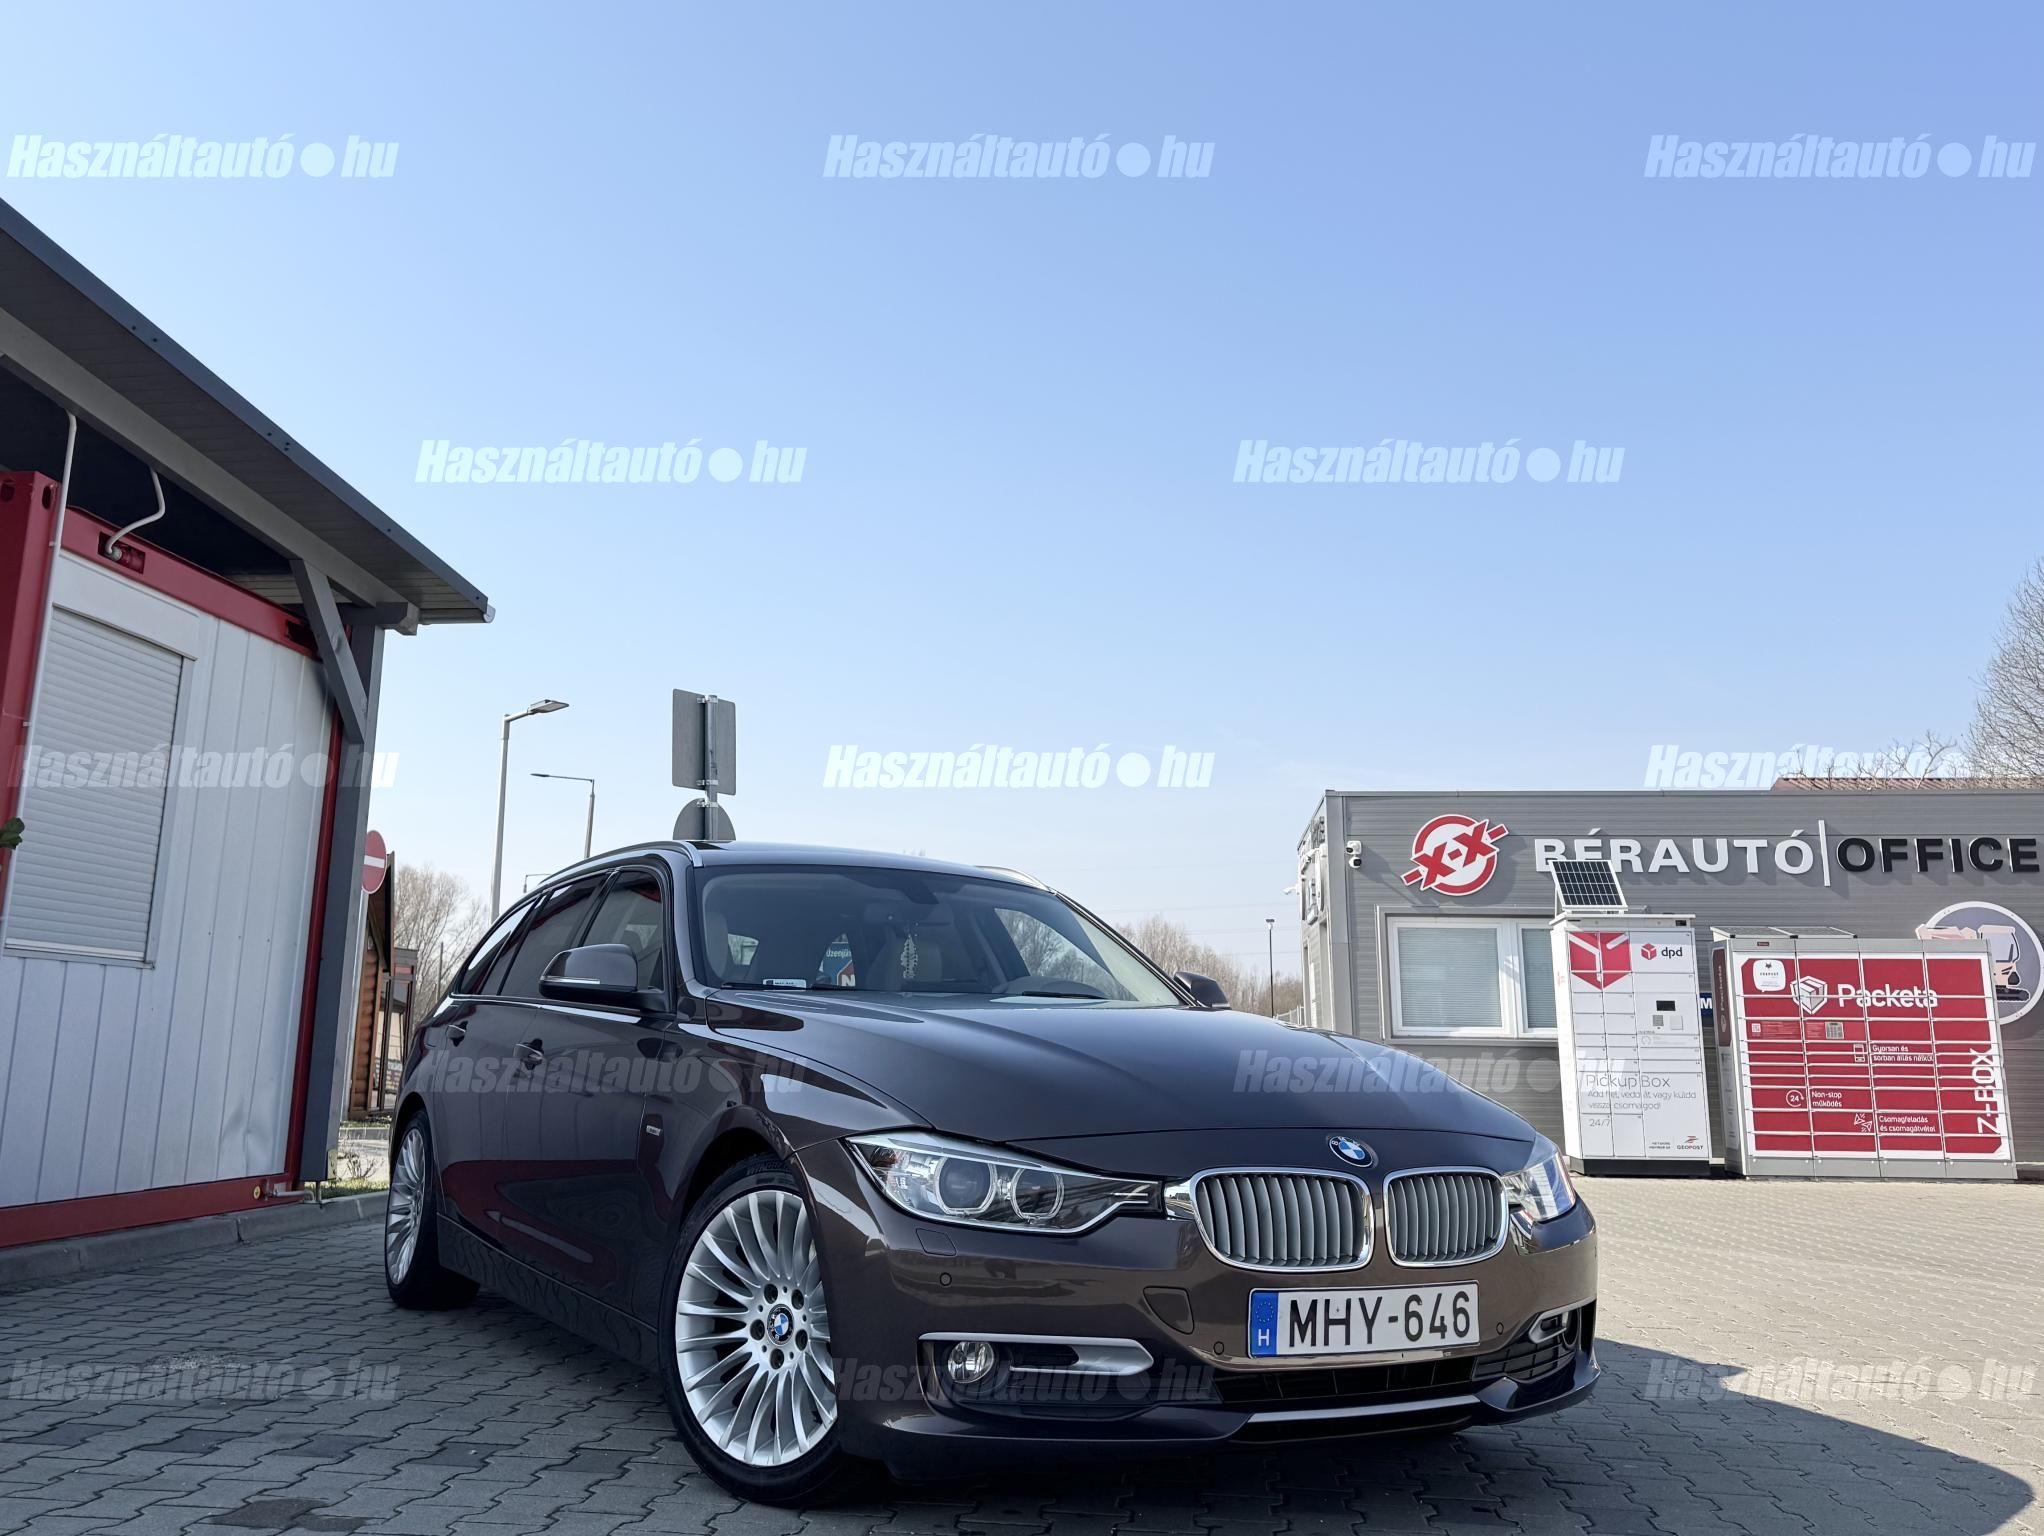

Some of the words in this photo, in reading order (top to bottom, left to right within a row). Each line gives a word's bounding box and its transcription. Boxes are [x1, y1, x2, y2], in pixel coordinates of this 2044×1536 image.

[1534, 828, 1815, 876] BÉRAUTÓ
[1836, 837, 2041, 874] OFFICE
[1661, 947, 1683, 959] dpd
[1838, 984, 1938, 1008] Packeta
[1872, 1044, 1899, 1053] Gyorsan
[1586, 1074, 1637, 1089] Pickup
[1641, 1074, 1671, 1088] Box
[1811, 1091, 1842, 1099] Non-stop
[1970, 1048, 2001, 1134] Z-BOX
[1589, 1119, 1610, 1127] 24/7
[1257, 1328, 1270, 1347] H
[1288, 1290, 1470, 1348] MHY-646
